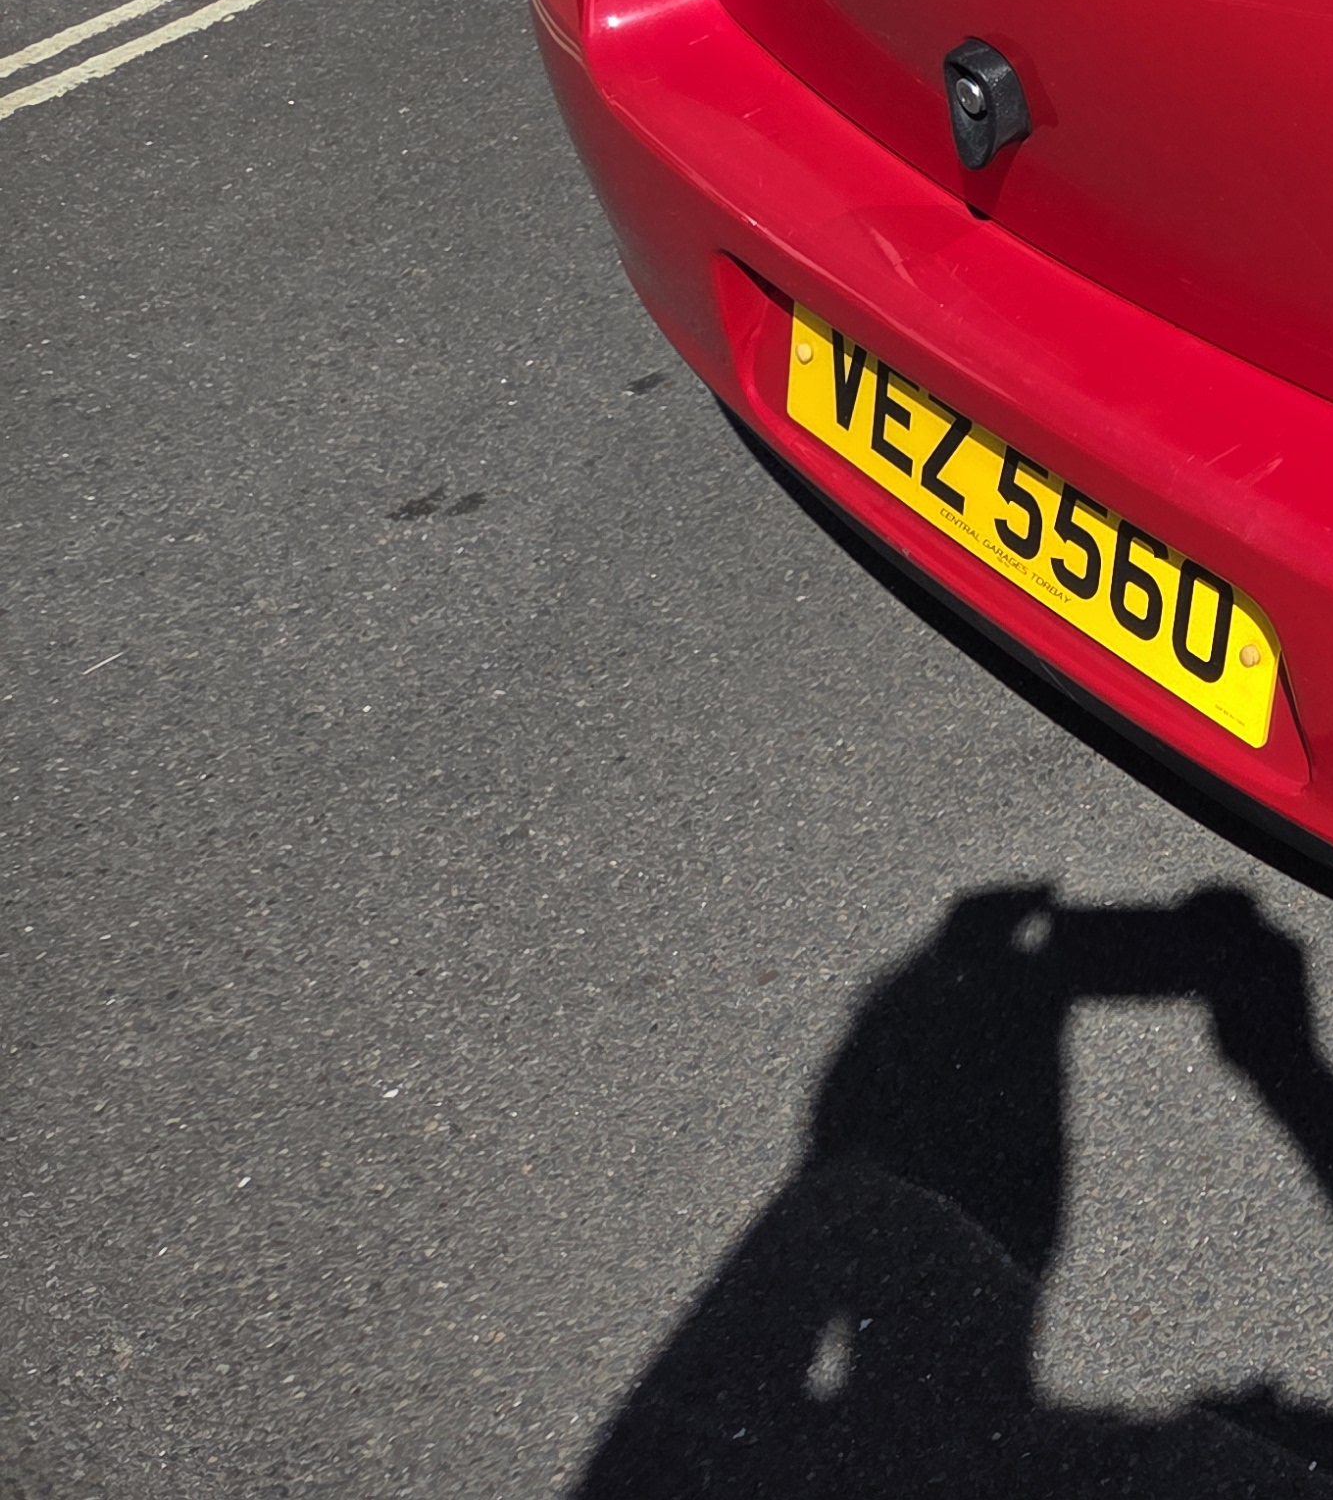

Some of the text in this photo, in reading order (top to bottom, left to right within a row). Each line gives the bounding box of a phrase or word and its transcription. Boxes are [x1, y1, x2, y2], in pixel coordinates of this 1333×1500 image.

[831, 327, 1235, 684] VEZ 5560
[940, 507, 1073, 604] CENTRAL GARAGES TORBAY
